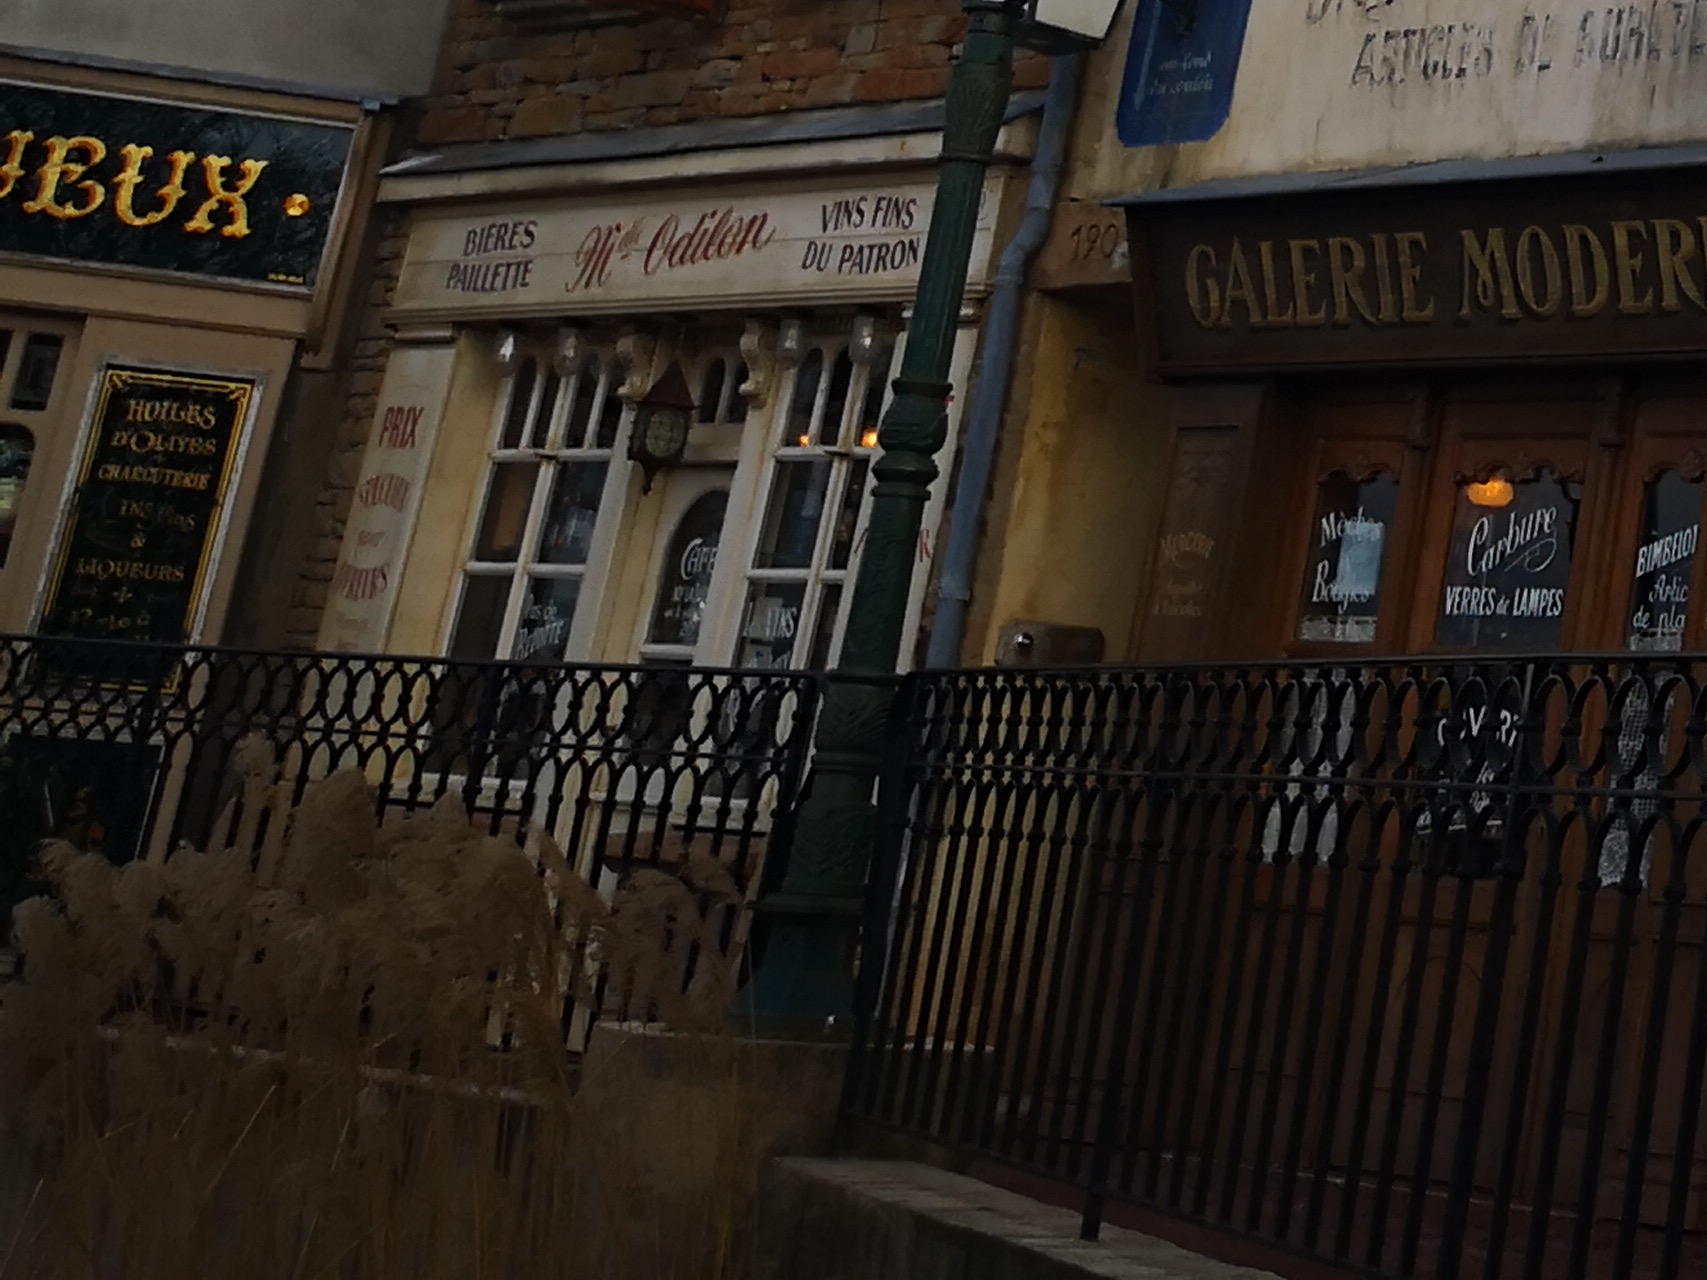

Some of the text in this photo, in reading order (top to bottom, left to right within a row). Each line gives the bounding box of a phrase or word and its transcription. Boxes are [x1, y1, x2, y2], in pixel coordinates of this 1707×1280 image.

[819, 194, 918, 233] VINS FINS
[462, 220, 537, 259] BIERES
[802, 236, 919, 276] DU PATRON
[445, 259, 534, 292] PAILLETTE
[1184, 231, 1436, 331] GALERIE
[126, 397, 217, 431] HUILES
[378, 405, 425, 450] PRIX
[1466, 506, 1559, 578] Carbure
[1445, 586, 1496, 618] VERRES
[1513, 586, 1564, 618] LAMPES
[1632, 605, 1650, 629] de
